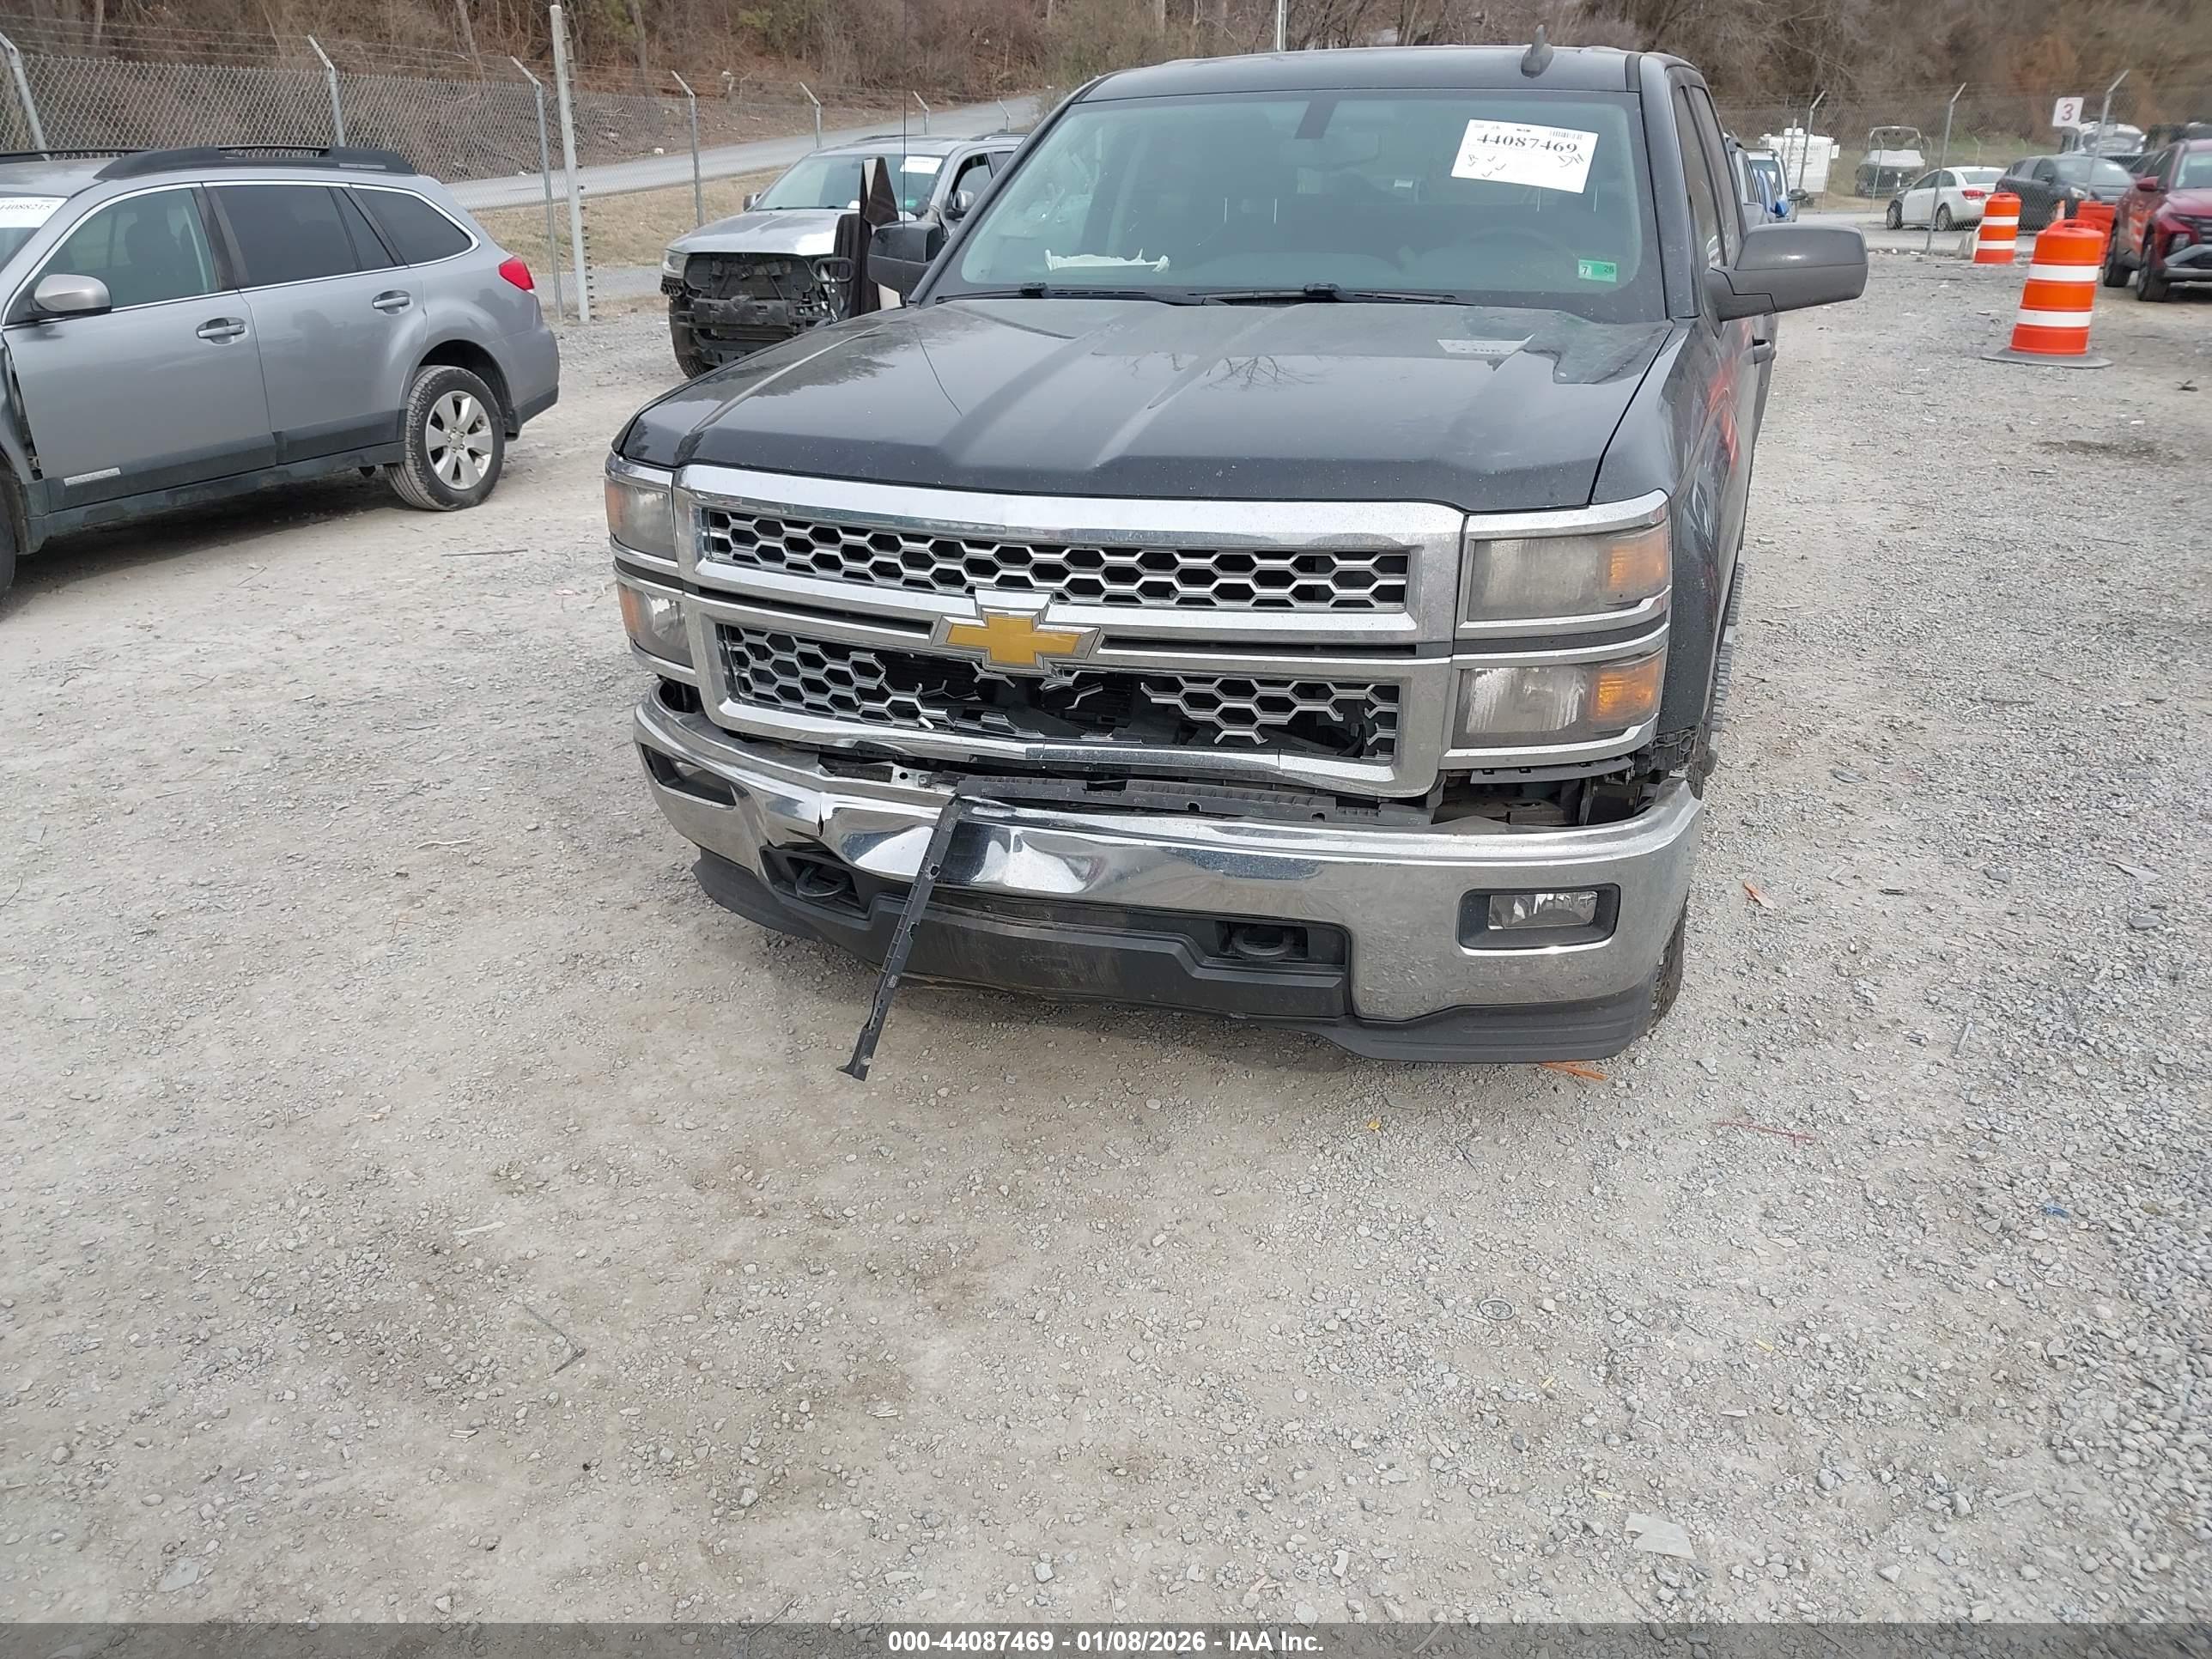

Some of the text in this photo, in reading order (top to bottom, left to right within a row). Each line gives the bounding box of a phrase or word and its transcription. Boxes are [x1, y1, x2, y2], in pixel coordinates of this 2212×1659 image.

[2062, 103, 2074, 121] 3
[1476, 132, 1578, 154] 44087469
[1582, 265, 1589, 276] 7
